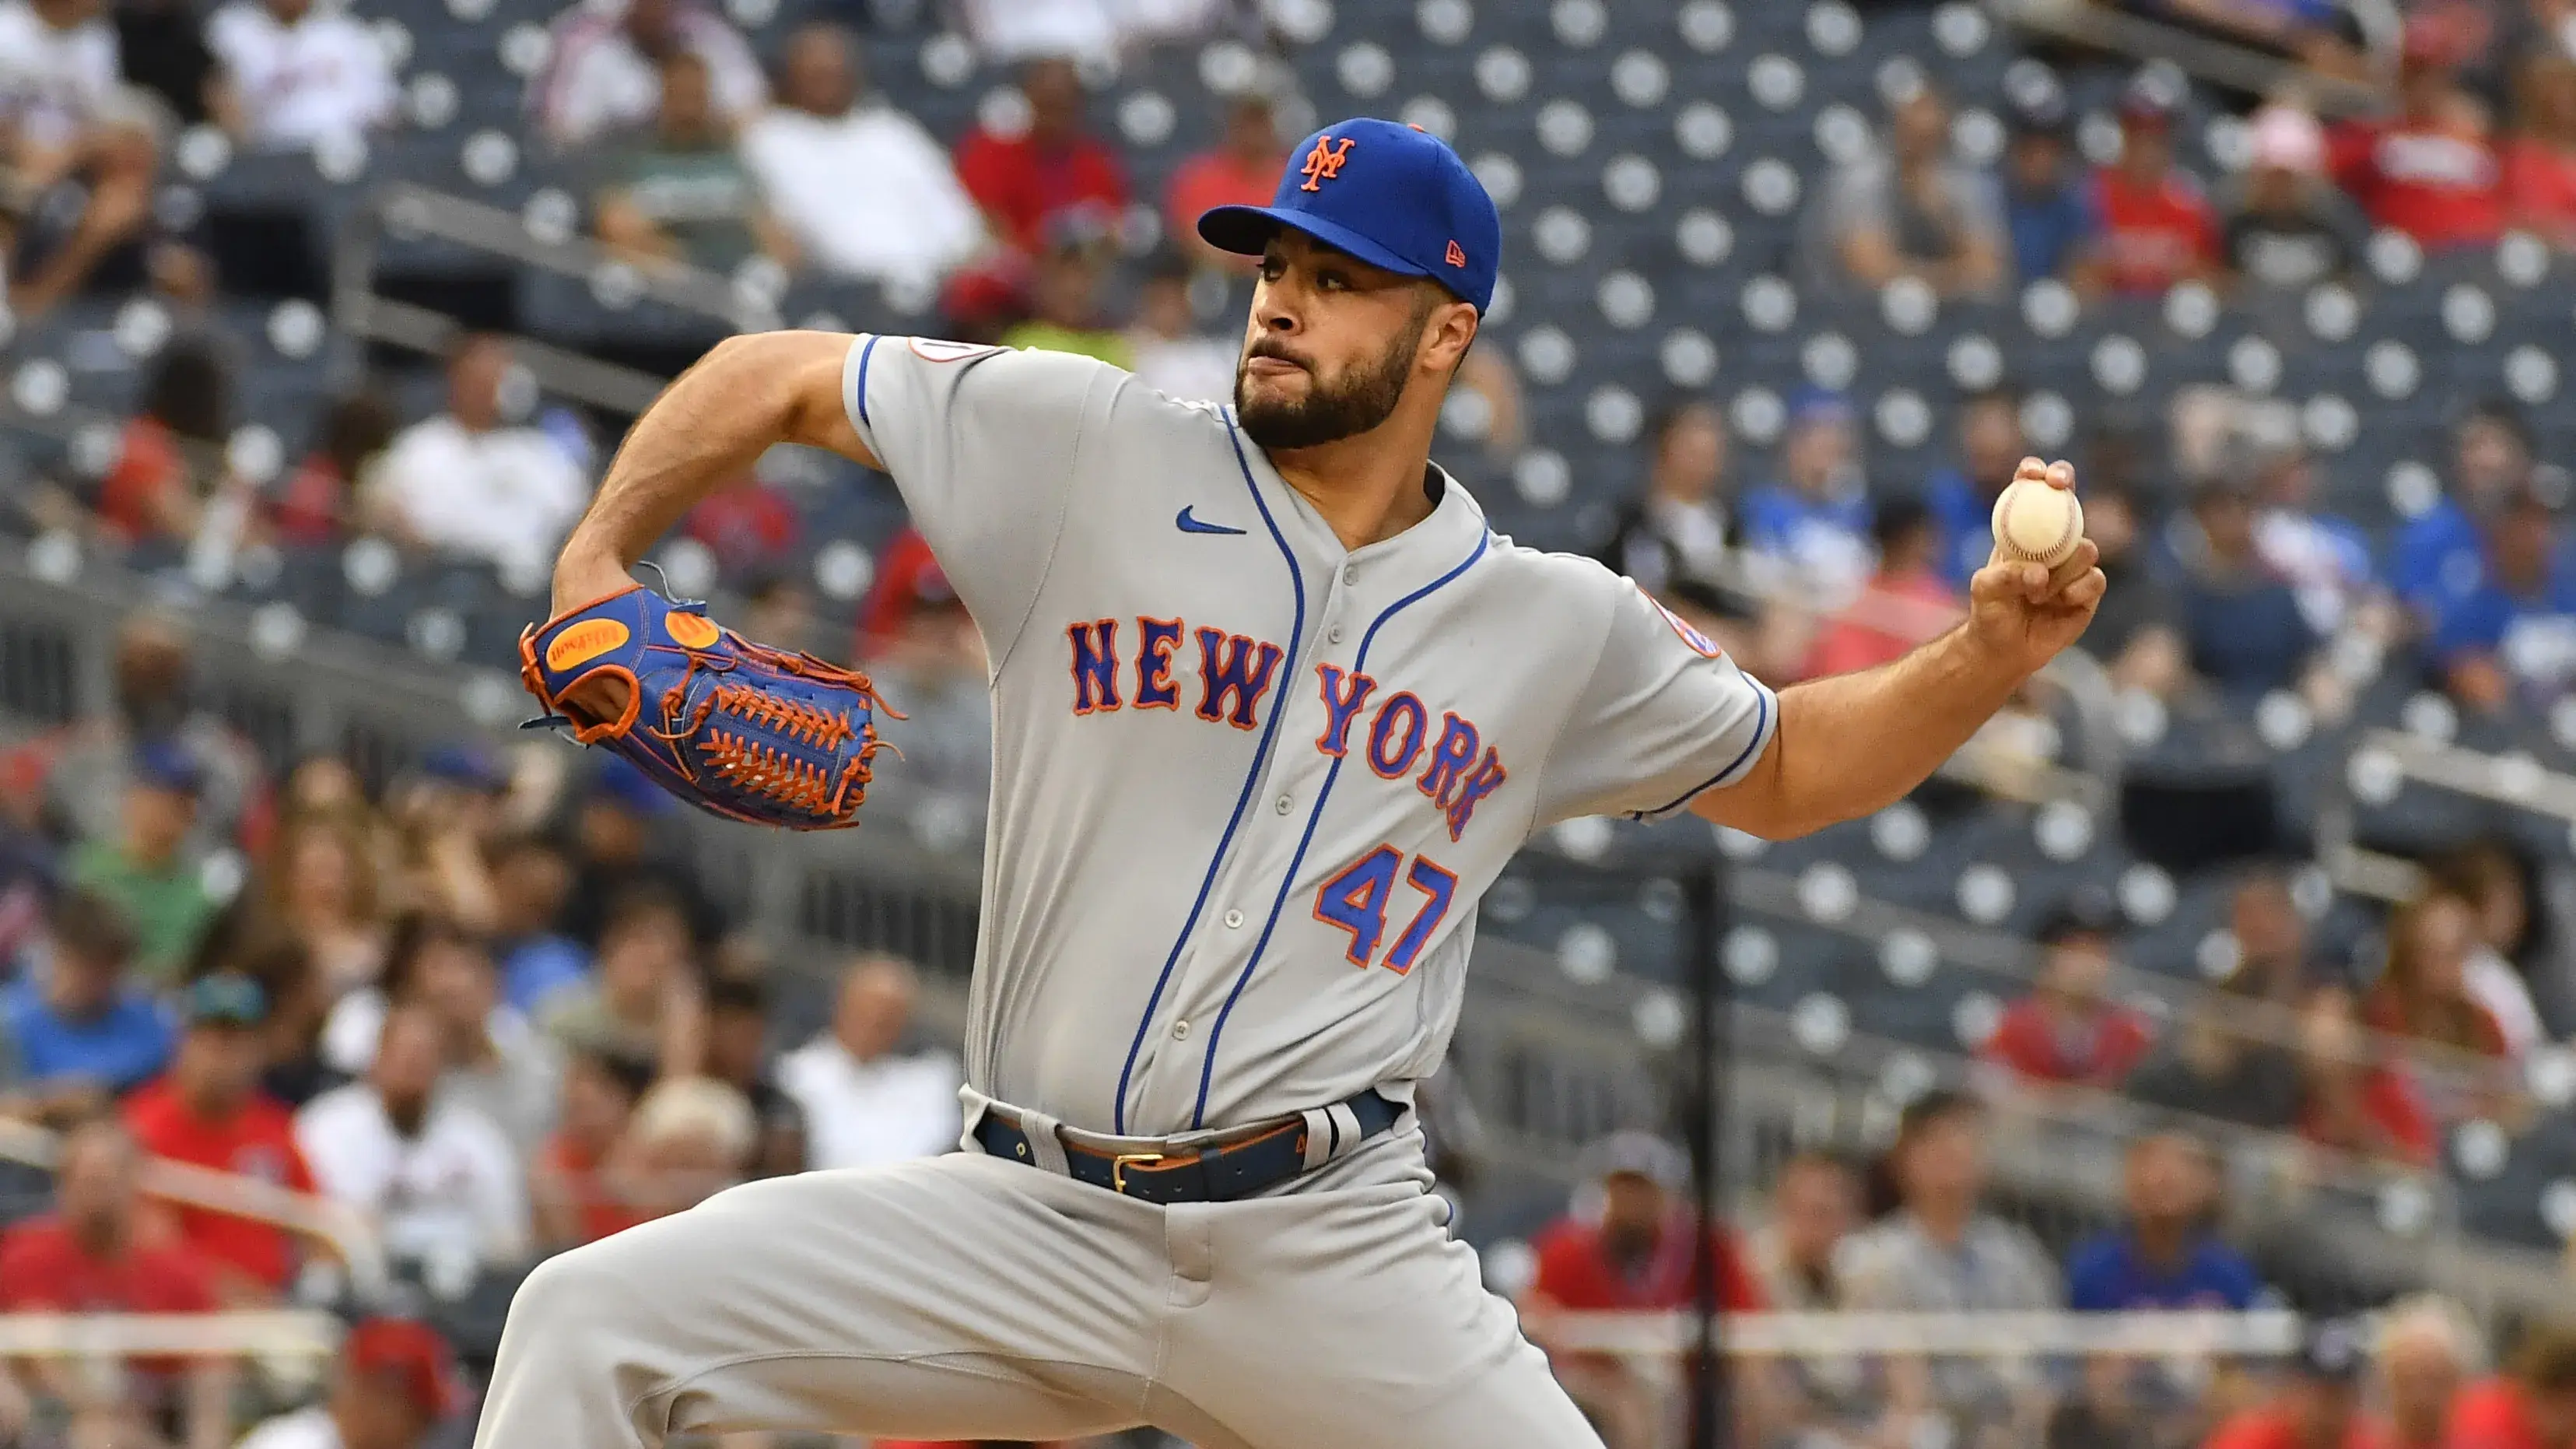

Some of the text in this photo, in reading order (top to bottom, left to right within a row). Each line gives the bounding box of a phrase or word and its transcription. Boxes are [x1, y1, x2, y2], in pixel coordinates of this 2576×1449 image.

[1067, 616, 1507, 842] NEW YORK
[1313, 842, 1458, 976] 47
